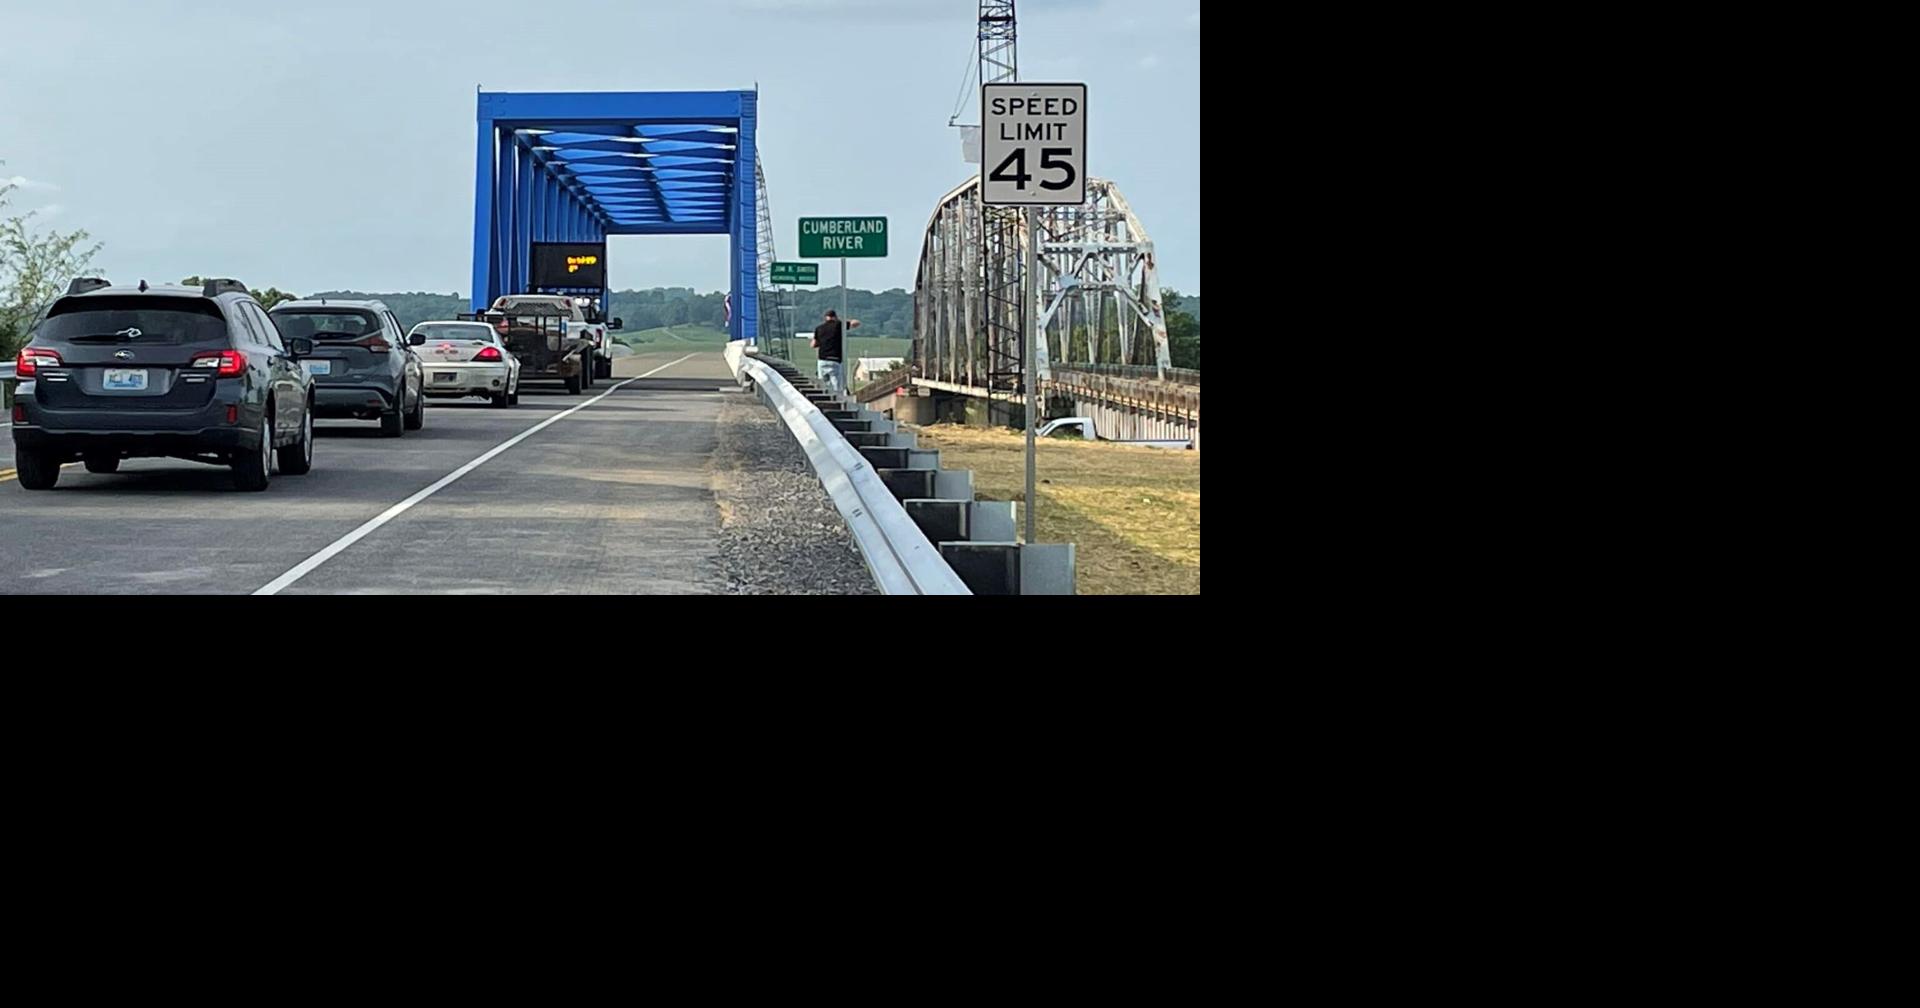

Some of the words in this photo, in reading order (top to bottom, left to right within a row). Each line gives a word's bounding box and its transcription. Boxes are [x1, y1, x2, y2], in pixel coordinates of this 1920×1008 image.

[991, 98, 1077, 116] SPEED
[1000, 123, 1067, 140] LIMIT
[989, 147, 1076, 191] 45
[803, 220, 884, 234] CUMBERLAND
[823, 236, 863, 249] RIVER
